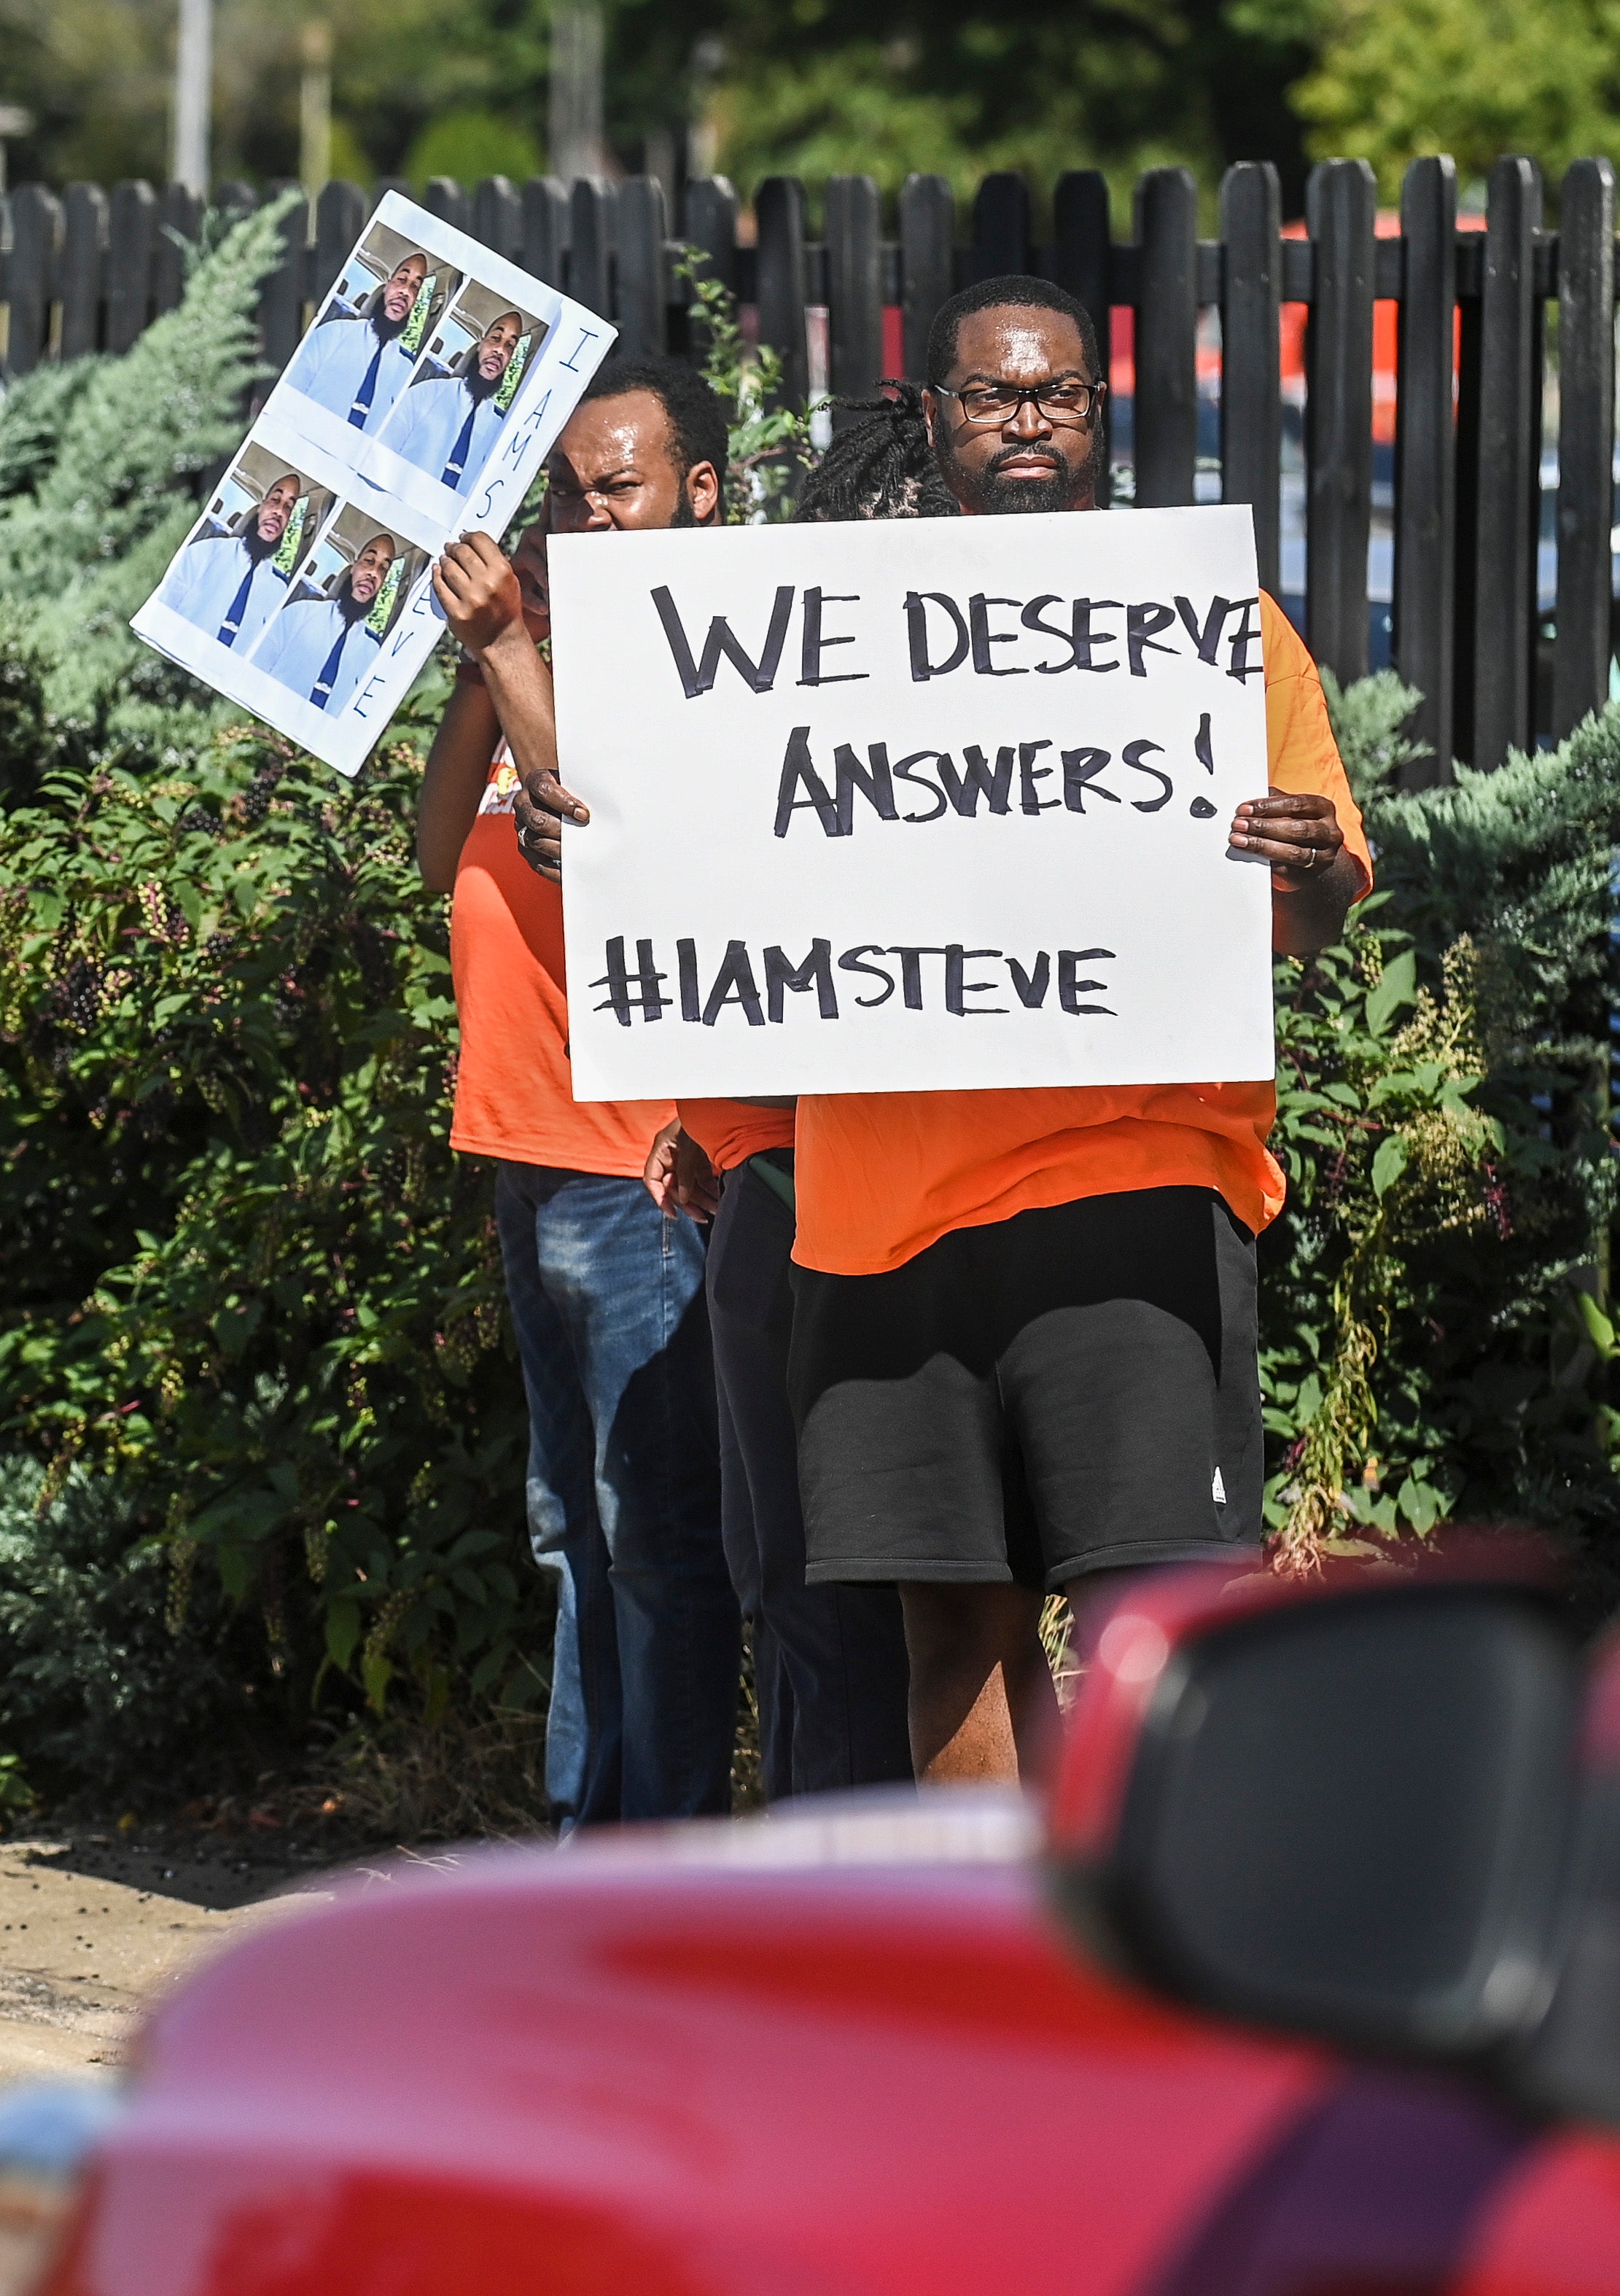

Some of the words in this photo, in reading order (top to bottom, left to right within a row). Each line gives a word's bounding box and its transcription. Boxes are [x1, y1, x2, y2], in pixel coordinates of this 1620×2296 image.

[558, 327, 599, 373] I
[354, 479, 505, 718] SEVE
[650, 585, 870, 699] WE
[902, 590, 1264, 685] DESERVE
[774, 712, 1218, 838] ANSWERS!
[588, 935, 1118, 1027] #IAMSTEVE
